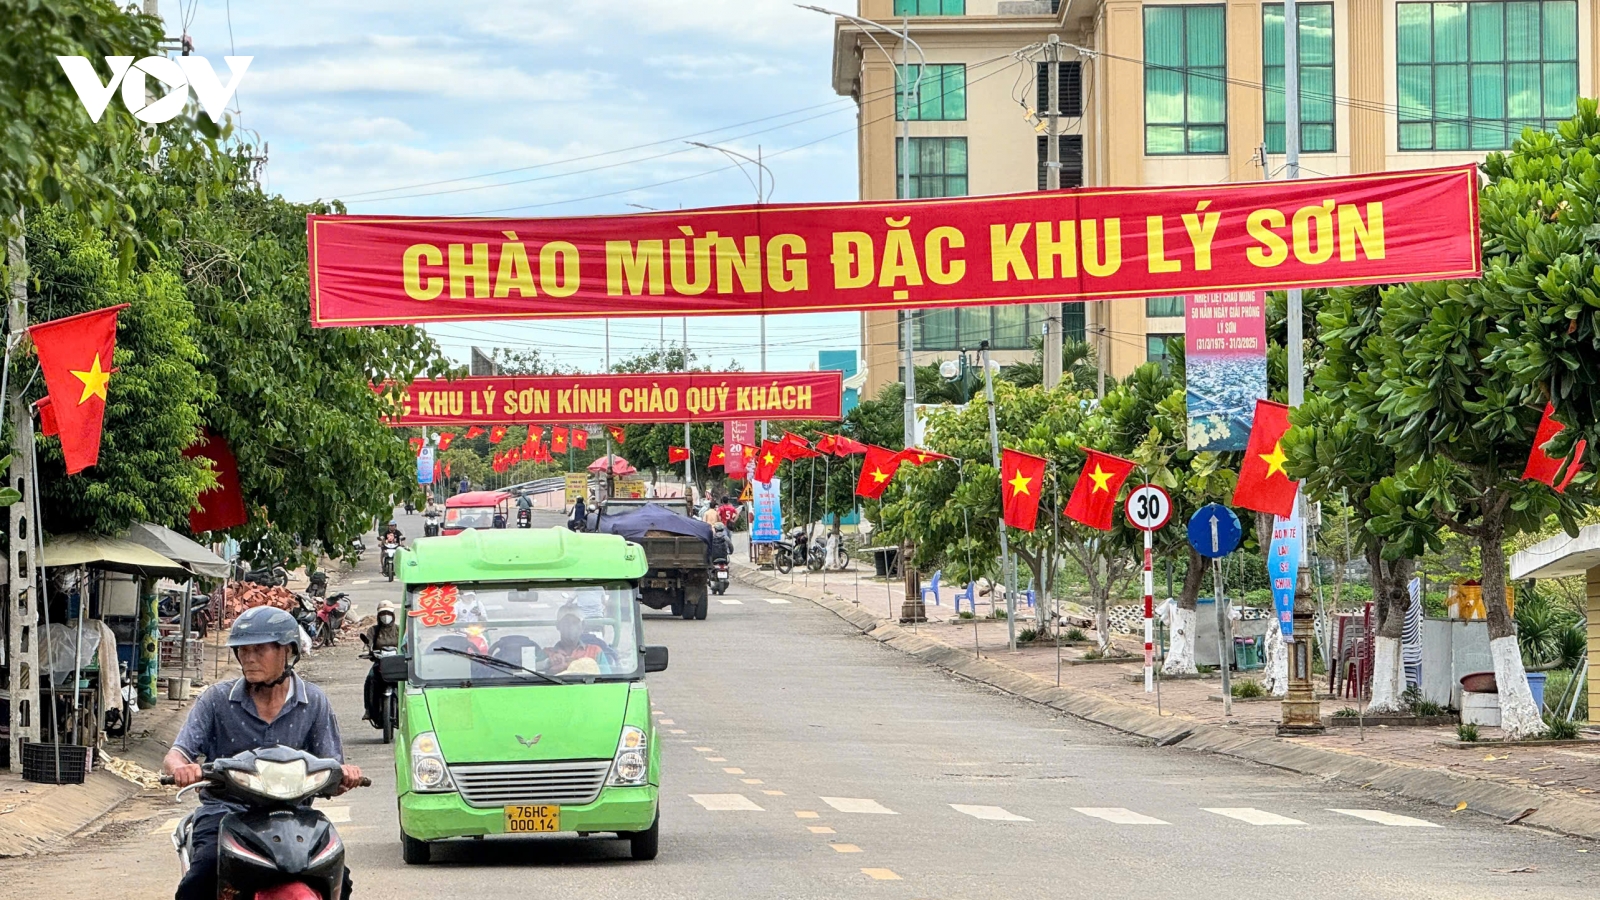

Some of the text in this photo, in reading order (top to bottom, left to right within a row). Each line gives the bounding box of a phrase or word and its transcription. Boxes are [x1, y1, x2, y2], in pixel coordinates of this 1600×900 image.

[403, 198, 1386, 300] CHÀO MỪNG ĐẶC KHU LÝ SƠN
[1191, 307, 1199, 318] 50
[1213, 304, 1228, 318] NGÀY
[1229, 303, 1240, 318] GIẢI
[1241, 304, 1260, 318] PHÓNG
[1217, 320, 1237, 334] LÝ SƠN
[419, 391, 463, 416] KHU
[471, 385, 496, 415] LÝ
[504, 387, 550, 415] SƠN
[557, 384, 611, 414] KÍNH
[618, 382, 678, 413] CHÀO
[686, 382, 730, 415] QUÝ
[736, 381, 812, 411] KHÁCH
[1137, 494, 1160, 519] 30
[725, 511, 731, 520] 5
[516, 806, 548, 818] 76HC
[510, 819, 554, 831] 000.14
